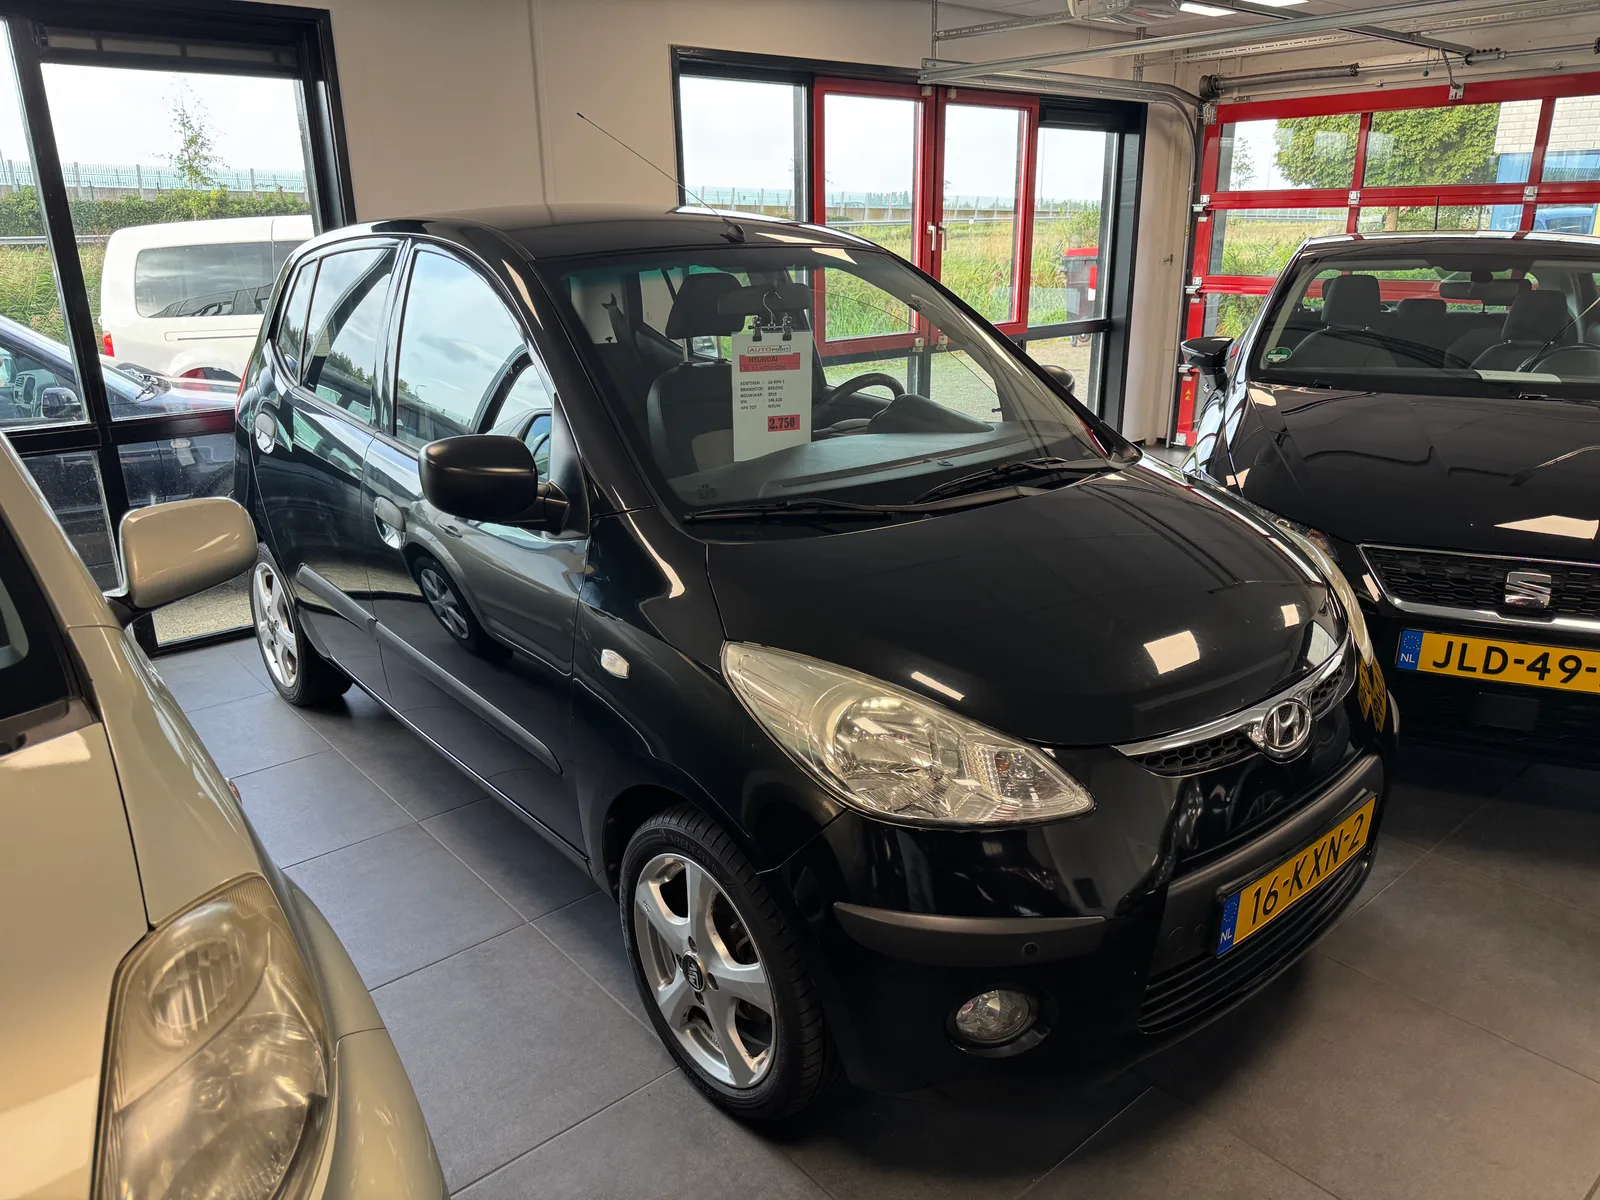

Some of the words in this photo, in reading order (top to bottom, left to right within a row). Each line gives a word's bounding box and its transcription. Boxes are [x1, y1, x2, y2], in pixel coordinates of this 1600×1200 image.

[748, 355, 778, 363] HYUNDAI
[769, 416, 796, 430] 2.750
[1400, 652, 1416, 664] NL
[1432, 640, 1600, 688] JLD-49-
[1219, 927, 1233, 944] NL
[1251, 812, 1365, 926] 16-KXN-2
